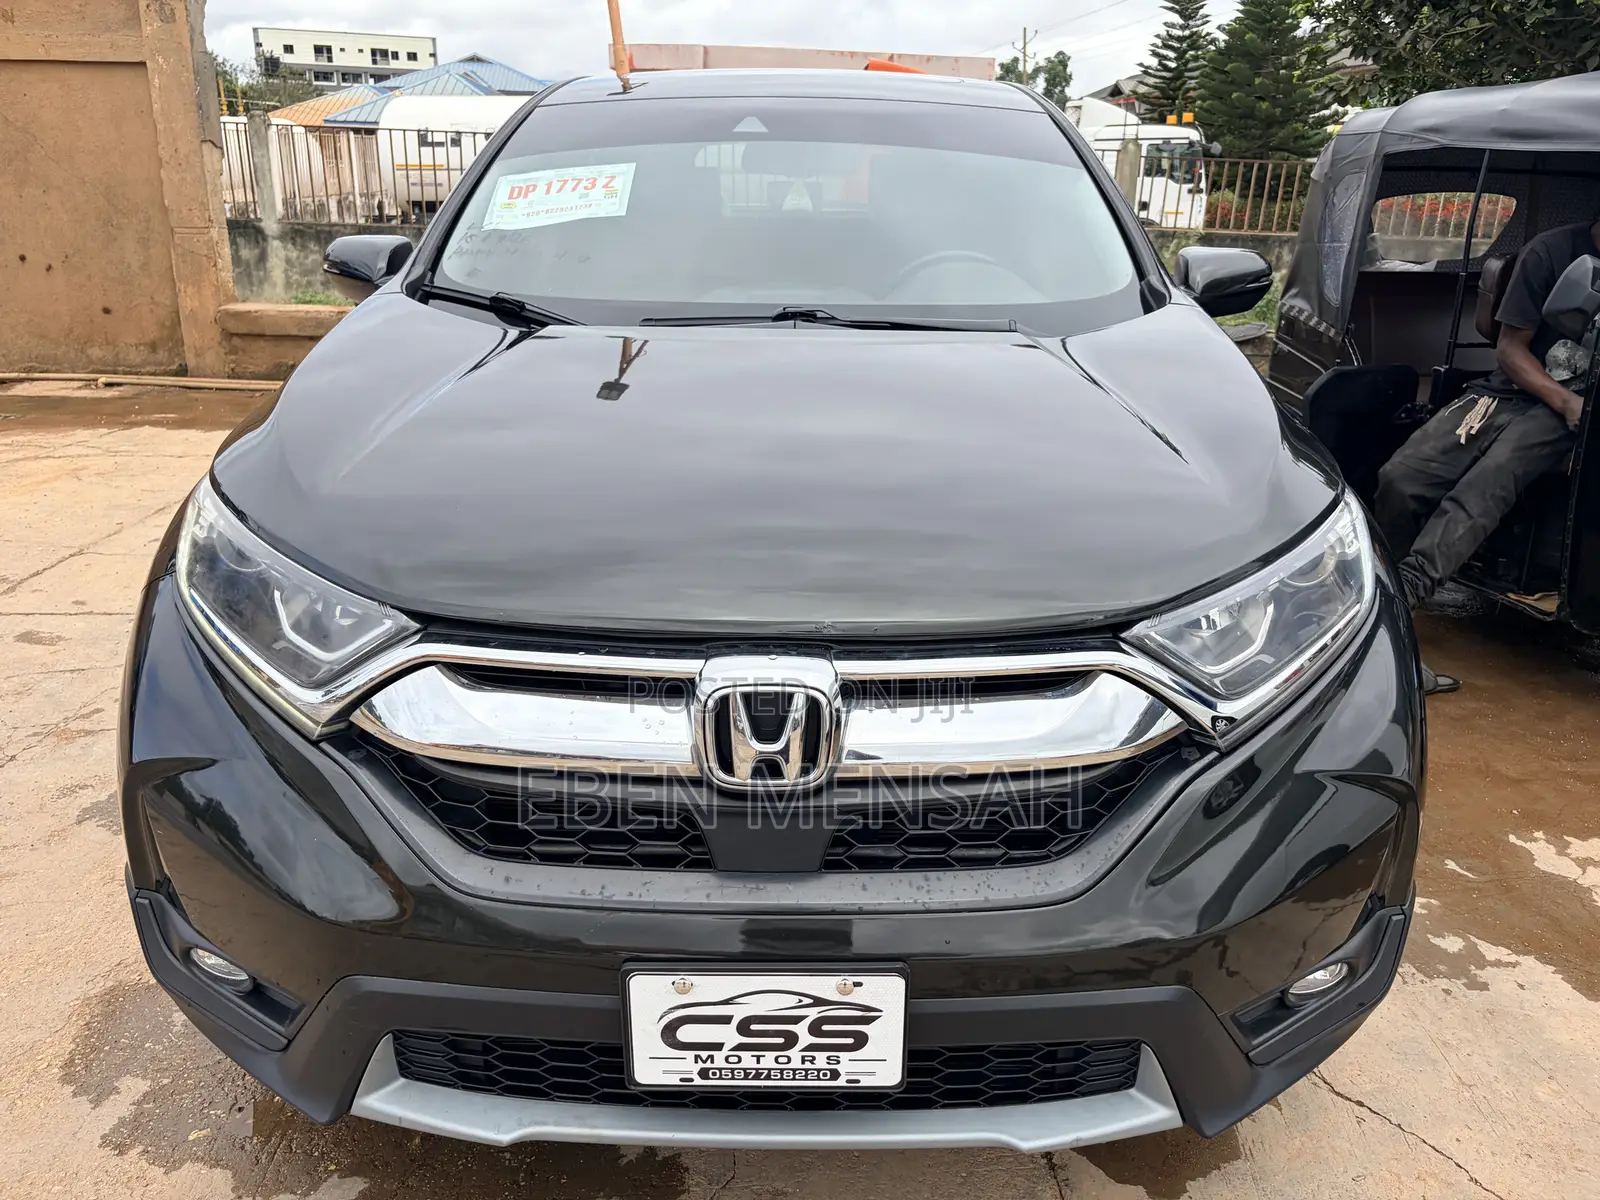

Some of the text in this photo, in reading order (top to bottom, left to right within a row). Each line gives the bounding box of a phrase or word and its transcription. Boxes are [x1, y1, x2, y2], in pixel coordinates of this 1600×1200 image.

[507, 175, 617, 201] DP 1773 Z
[660, 1014, 883, 1052] CSS
[693, 1054, 842, 1065] MOTORS
[708, 1068, 832, 1080] 0597758220
